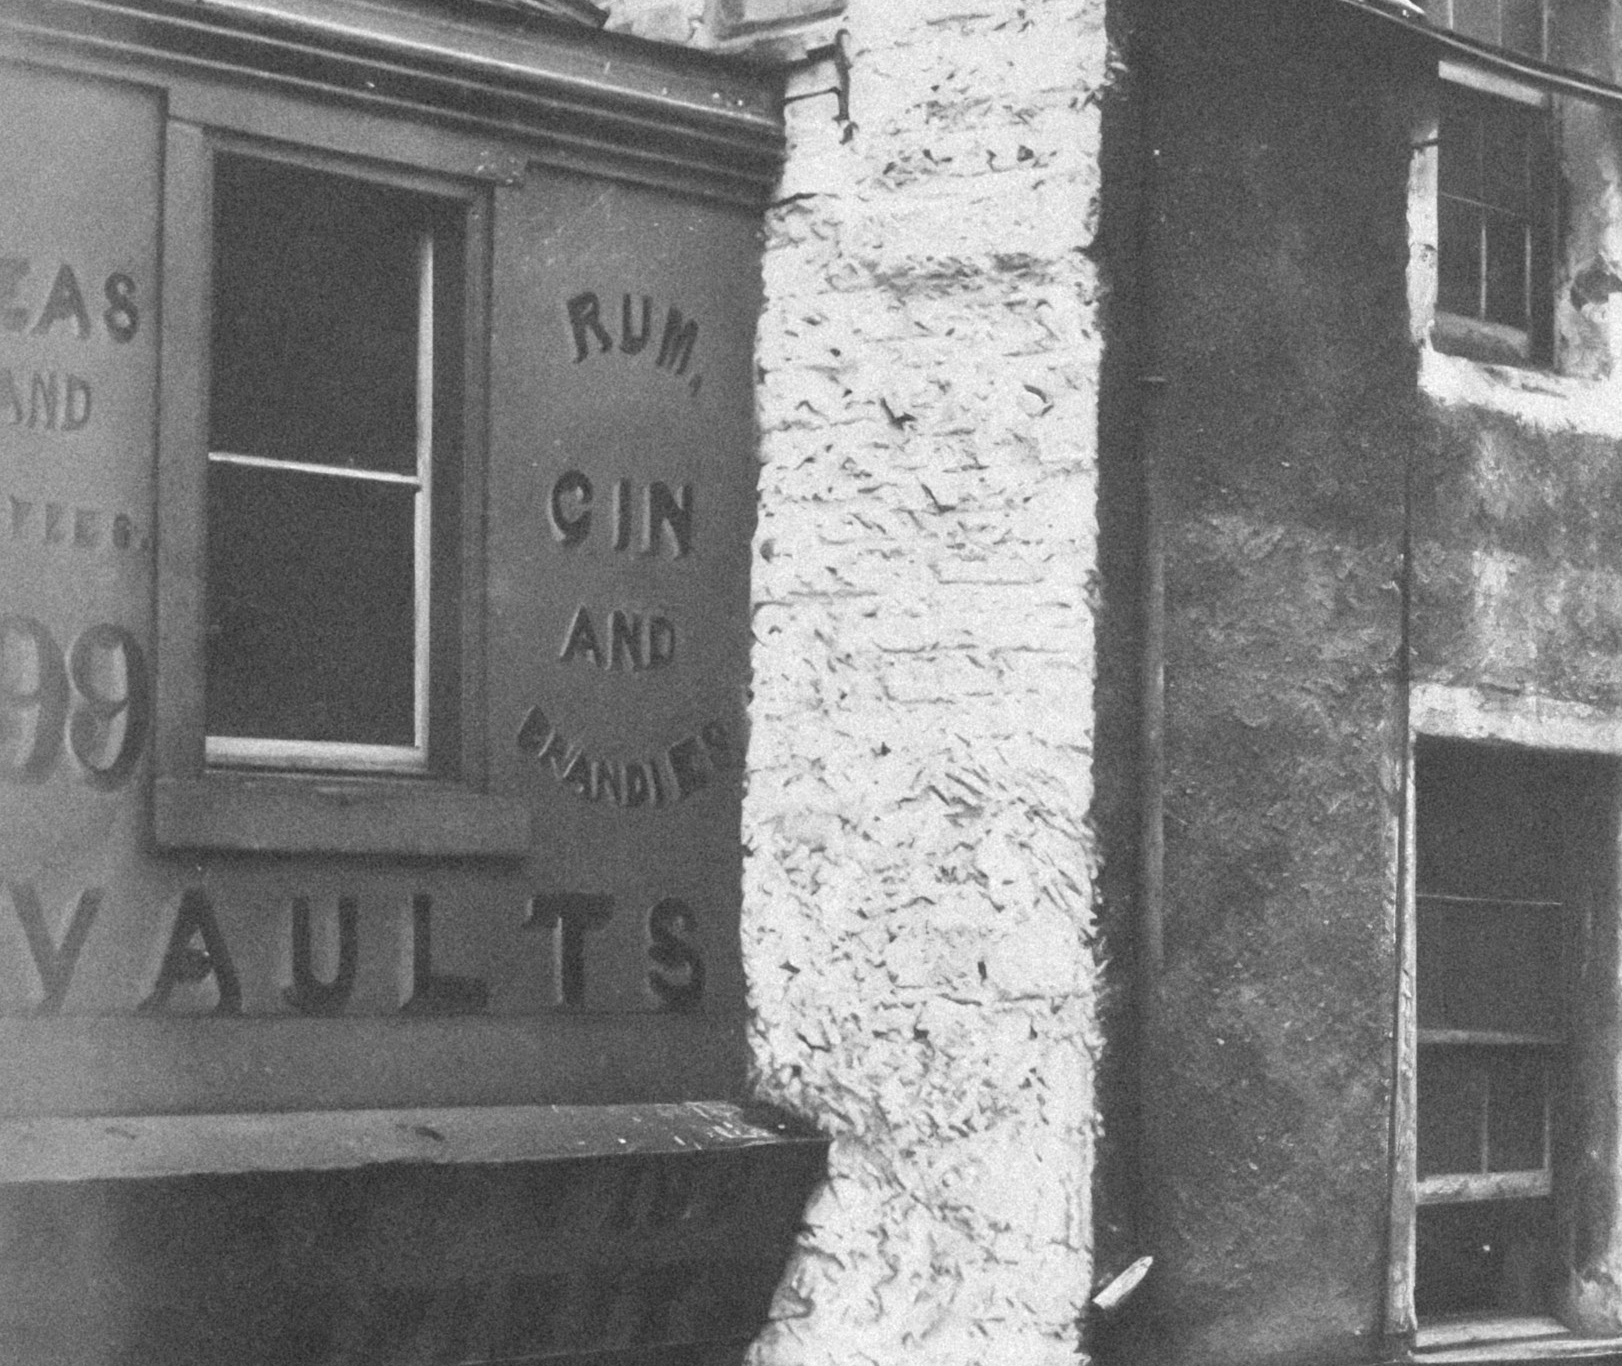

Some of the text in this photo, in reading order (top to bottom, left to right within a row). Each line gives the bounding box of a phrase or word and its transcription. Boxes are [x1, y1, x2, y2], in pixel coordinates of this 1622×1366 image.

[547, 469, 693, 560] GIN
[558, 603, 676, 673] AND
[9, 885, 705, 1014] VAULTS
